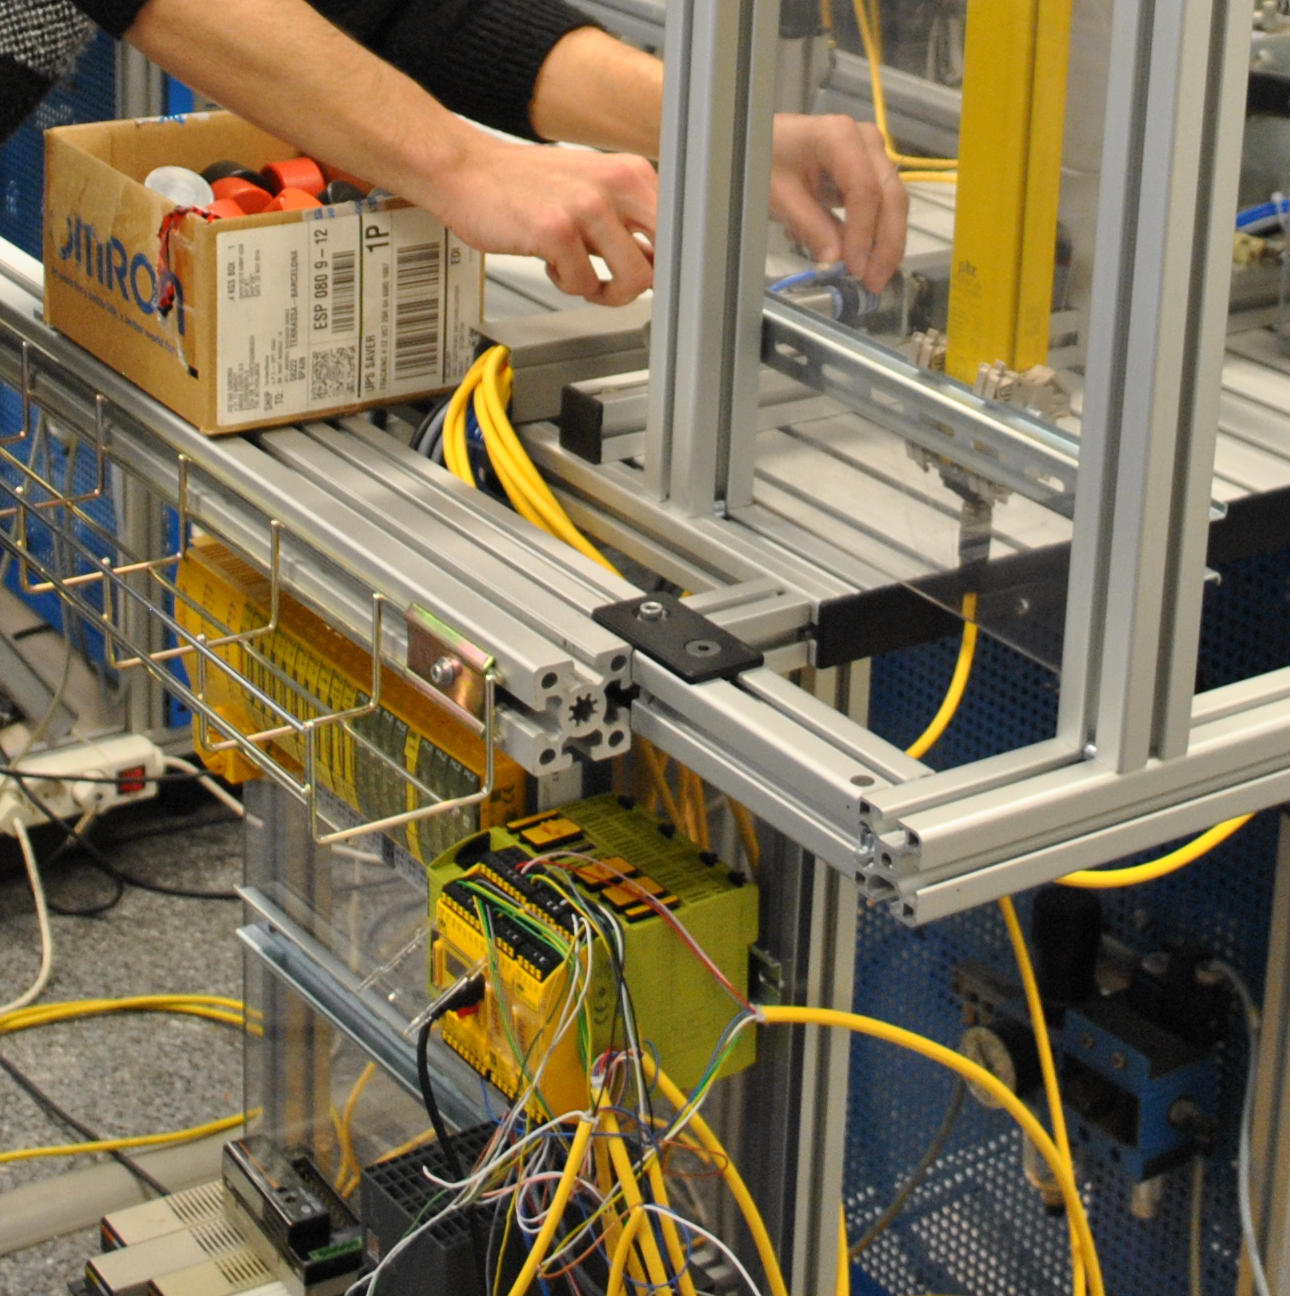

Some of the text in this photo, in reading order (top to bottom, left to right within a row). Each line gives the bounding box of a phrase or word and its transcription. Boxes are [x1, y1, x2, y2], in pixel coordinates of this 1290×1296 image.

[365, 225, 390, 253] 1P
[450, 247, 461, 265] EDI
[314, 273, 328, 299] 080
[314, 304, 328, 330] ESP
[364, 335, 375, 392] UPS SAVER
